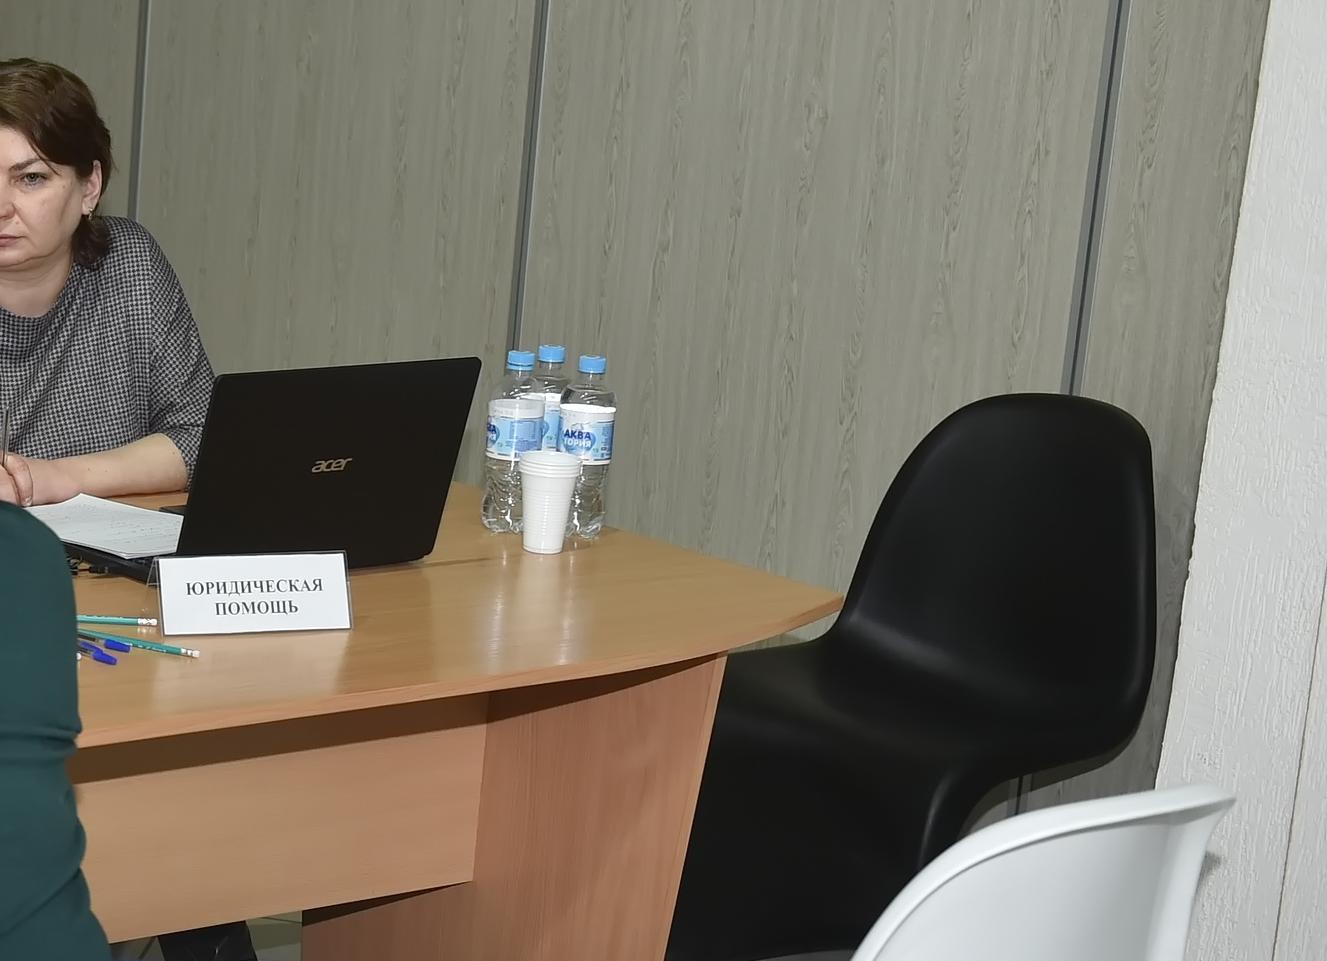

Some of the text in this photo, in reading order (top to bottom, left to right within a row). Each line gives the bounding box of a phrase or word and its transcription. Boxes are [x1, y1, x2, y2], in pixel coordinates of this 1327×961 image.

[564, 429, 592, 440] АКВА
[312, 458, 352, 472] acer
[186, 578, 323, 596] ЮРИДИЧЕСКАЯ
[215, 600, 299, 616] ПОМОЩЬ
